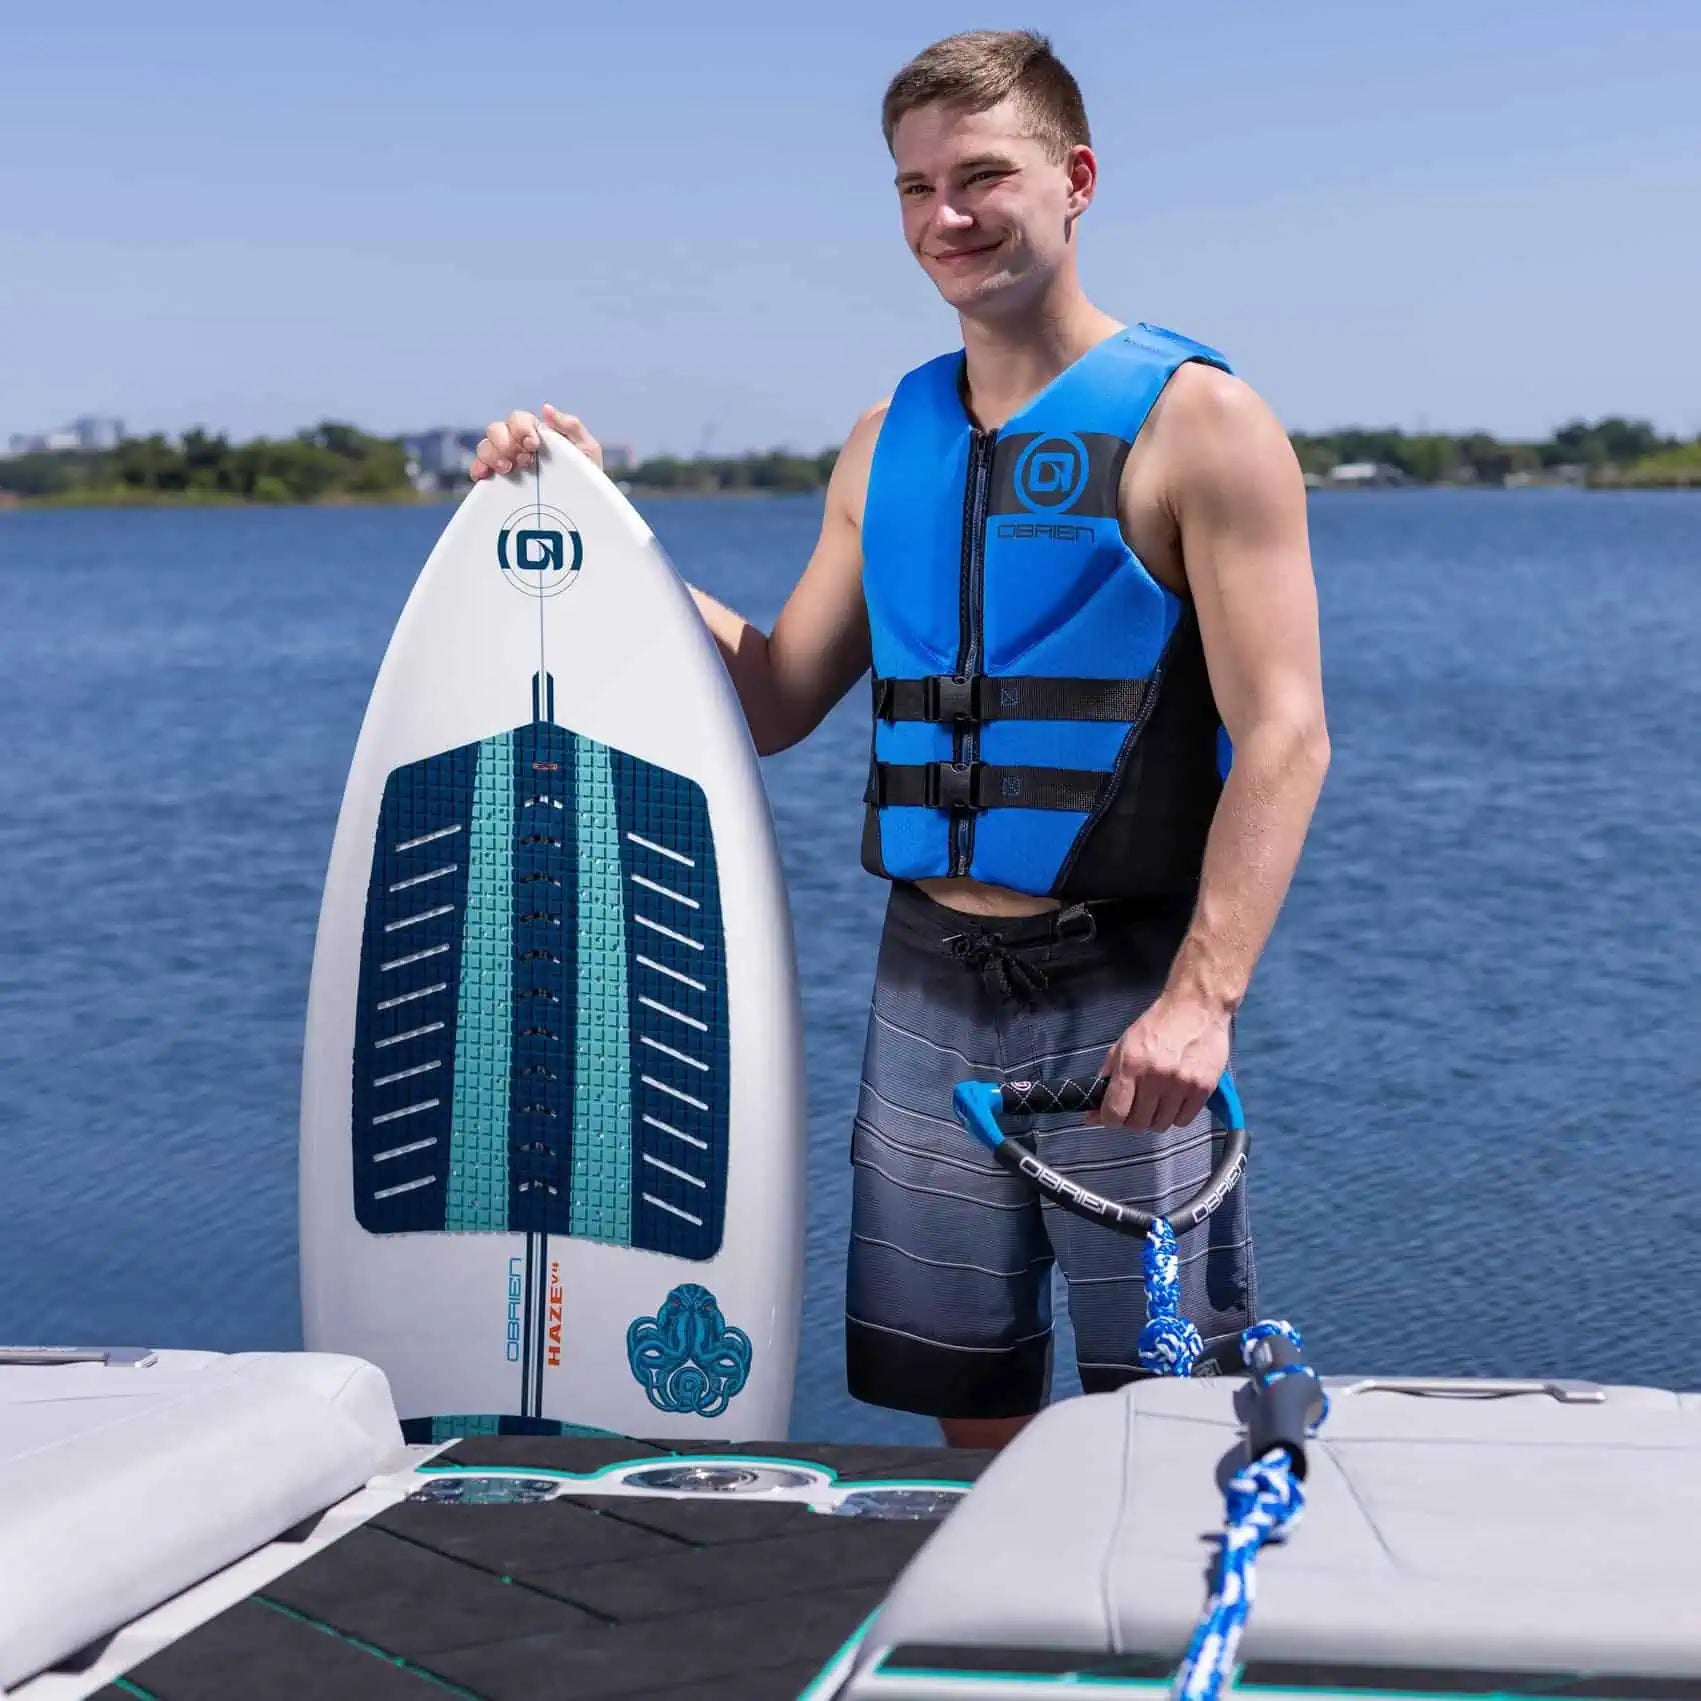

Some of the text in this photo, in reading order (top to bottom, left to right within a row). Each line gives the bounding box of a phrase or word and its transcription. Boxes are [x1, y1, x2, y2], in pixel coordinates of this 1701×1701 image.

[1019, 1156, 1123, 1222] OBRIEN
[507, 1257, 521, 1362] OBRIEN
[548, 1287, 562, 1366] HAZE
